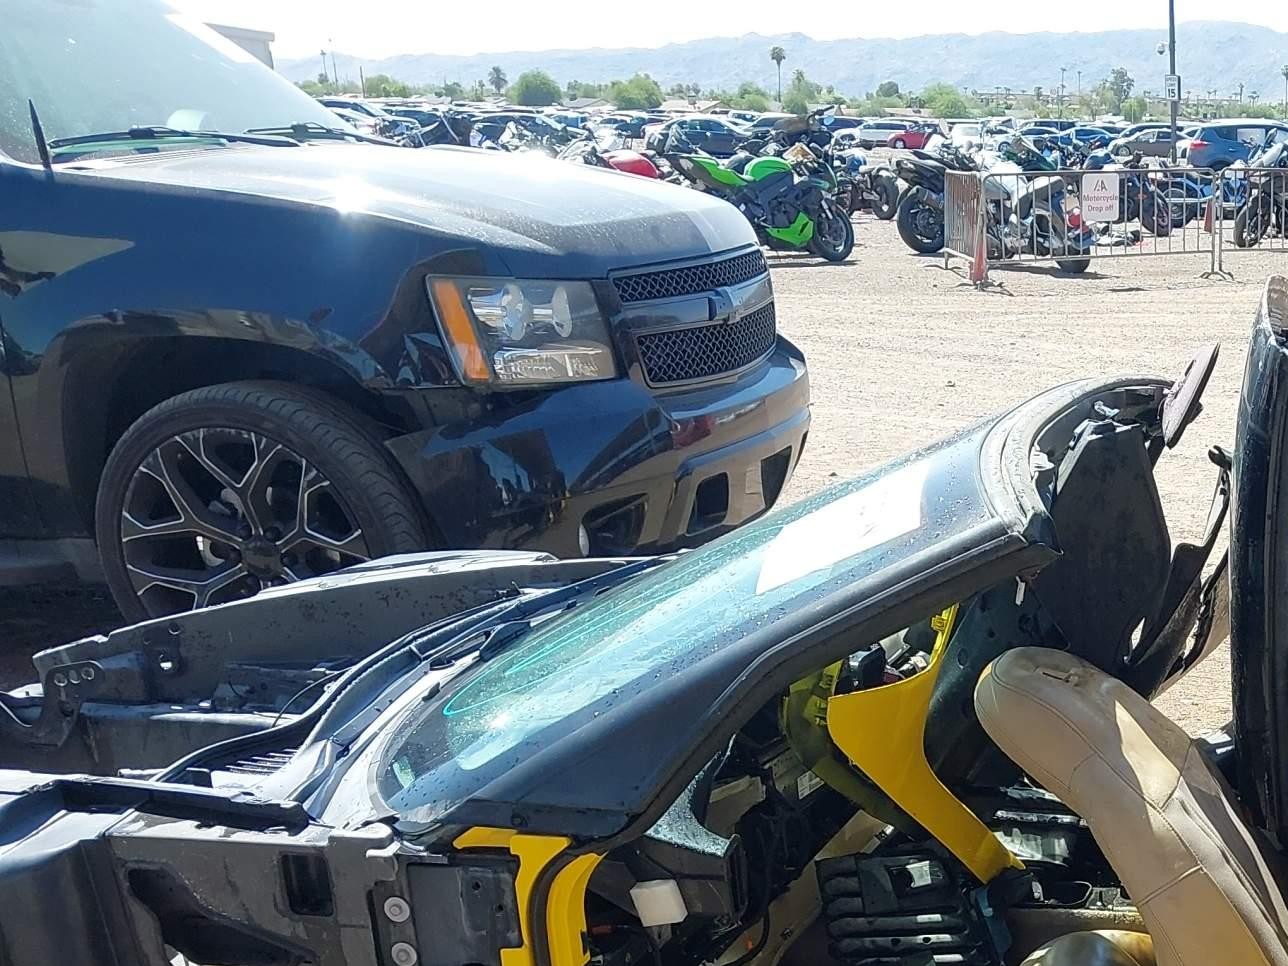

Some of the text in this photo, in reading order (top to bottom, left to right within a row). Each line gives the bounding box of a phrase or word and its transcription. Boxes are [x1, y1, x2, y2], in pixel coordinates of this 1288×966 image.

[1167, 88, 1176, 98] 15
[1083, 194, 1118, 202] Motorcycle
[1087, 204, 1104, 213] Drop
